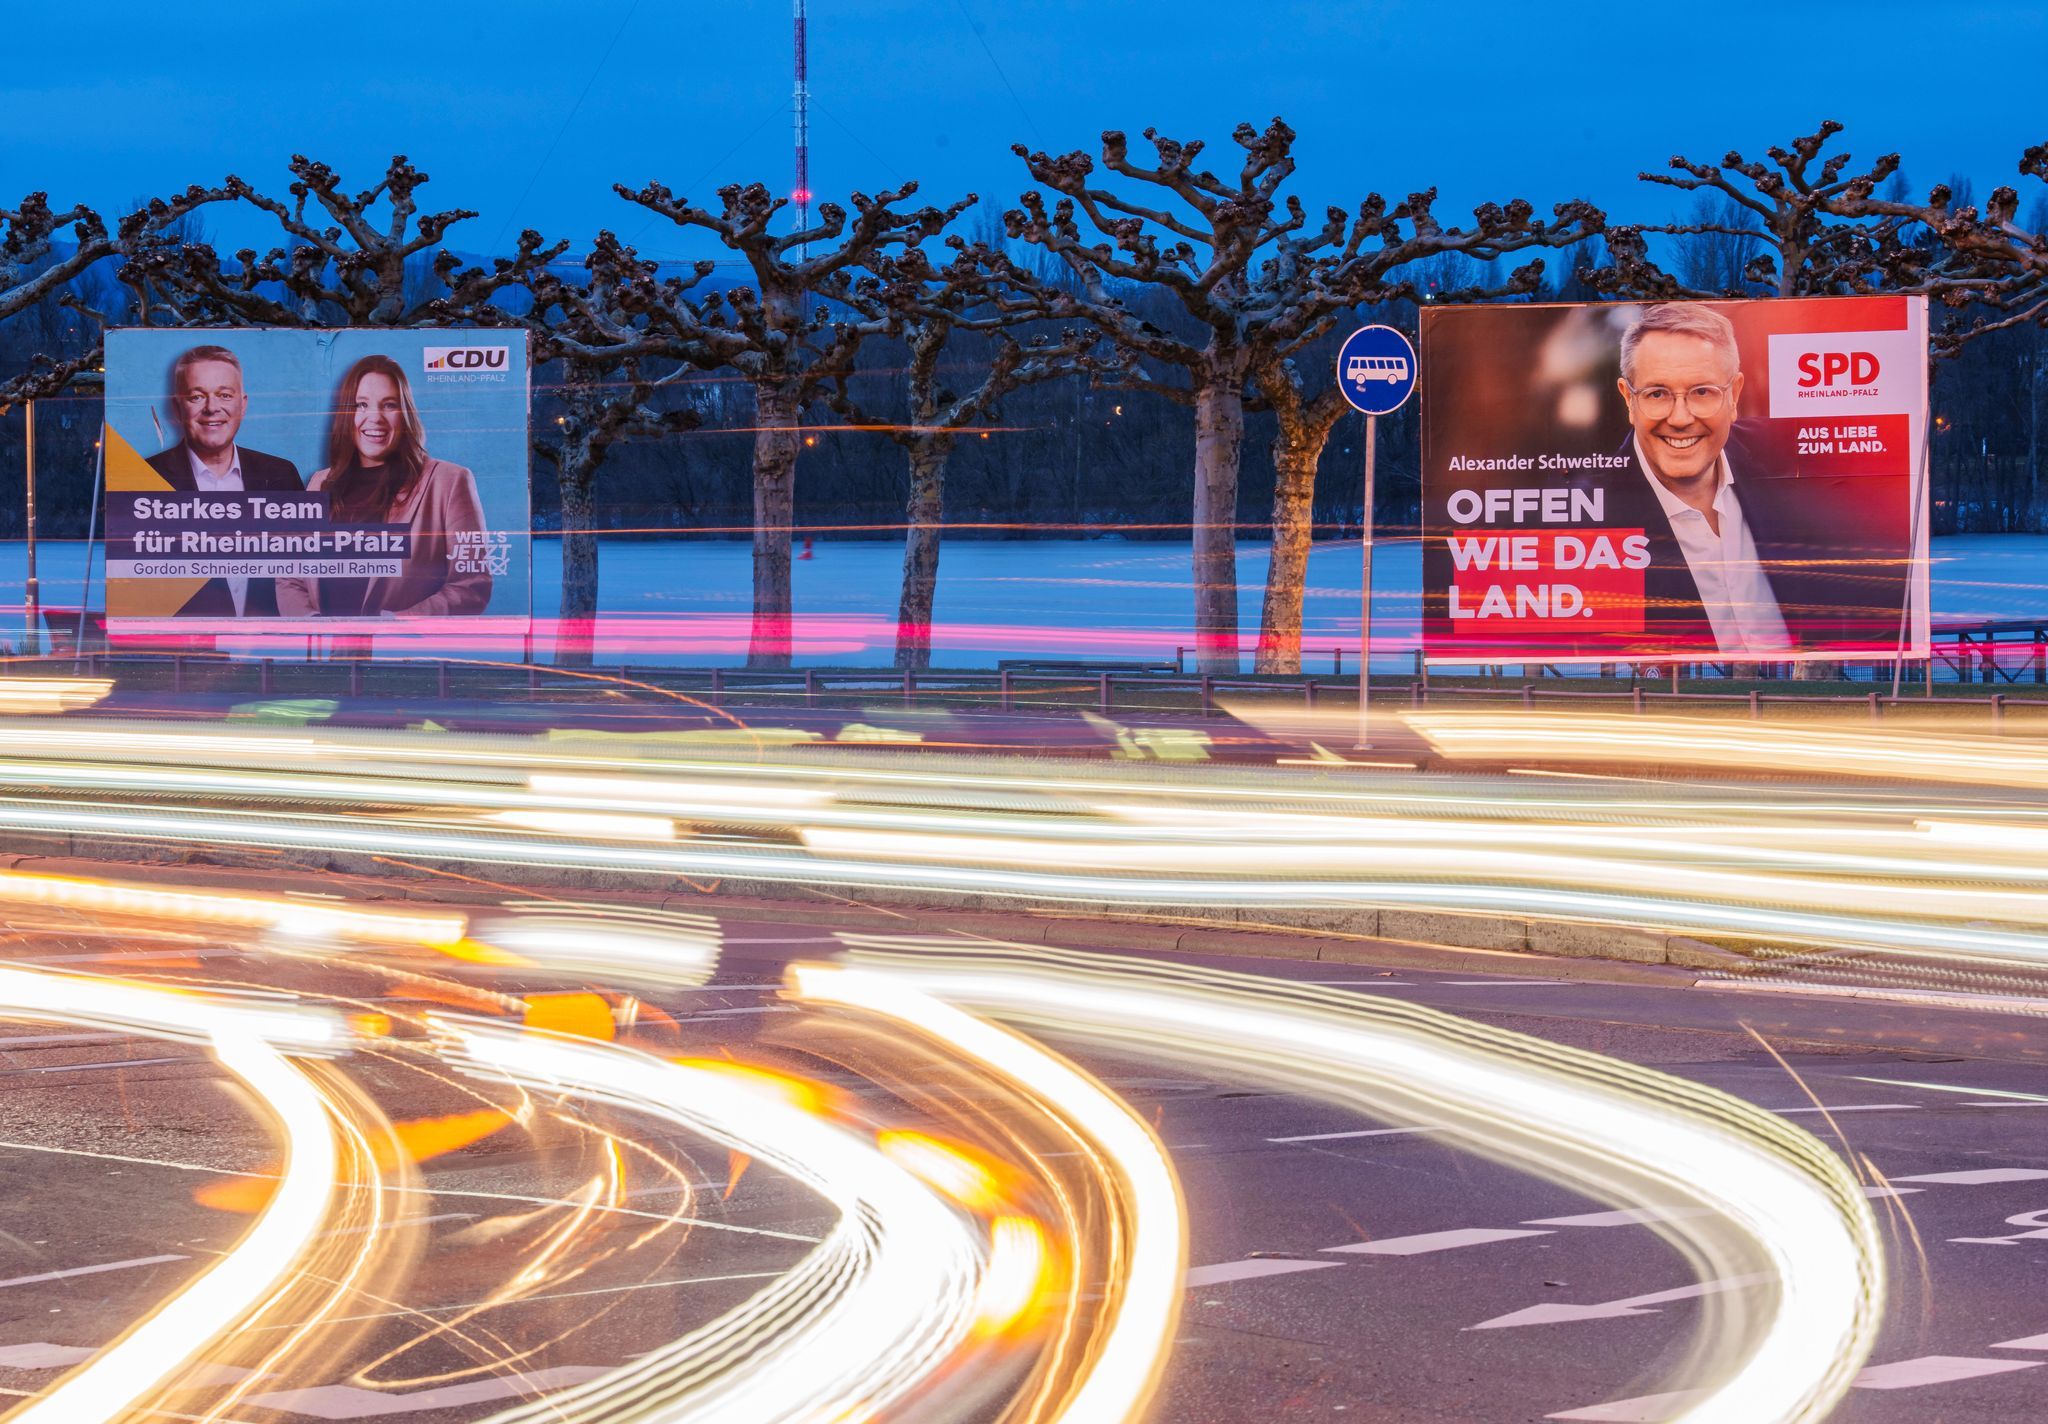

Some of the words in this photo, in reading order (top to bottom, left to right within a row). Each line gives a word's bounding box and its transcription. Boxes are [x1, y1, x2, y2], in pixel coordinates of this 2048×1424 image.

[447, 350, 505, 369] CDU
[427, 374, 506, 383] RHEINLAND-PFALZ
[1797, 352, 1880, 388] SPD
[1798, 388, 1879, 398] RHEINLAND-PFALZ
[1797, 427, 1830, 440] AUS
[1834, 425, 1878, 439] LIEBE
[1798, 442, 1833, 455] ZUM
[1839, 440, 1888, 454] LAND.
[1448, 455, 1534, 471] Alexander
[1538, 453, 1631, 470] Schweitzer
[133, 497, 242, 520] Starkes
[248, 497, 323, 519] Team
[1447, 488, 1604, 524] OFFEN
[133, 530, 176, 553] für
[181, 530, 404, 553] Rheinland-Pfalz
[455, 531, 508, 544] WEIL'S
[446, 544, 513, 560] JETZT
[1446, 536, 1539, 571] WIE
[1554, 534, 1652, 570] DAS
[133, 562, 187, 575] Gordon
[191, 562, 263, 575] Schnieder
[267, 562, 294, 575] und
[298, 562, 344, 575] Isabell
[349, 562, 397, 574] Rahms
[454, 560, 488, 573] GILT
[1449, 583, 1594, 619] LAND.
